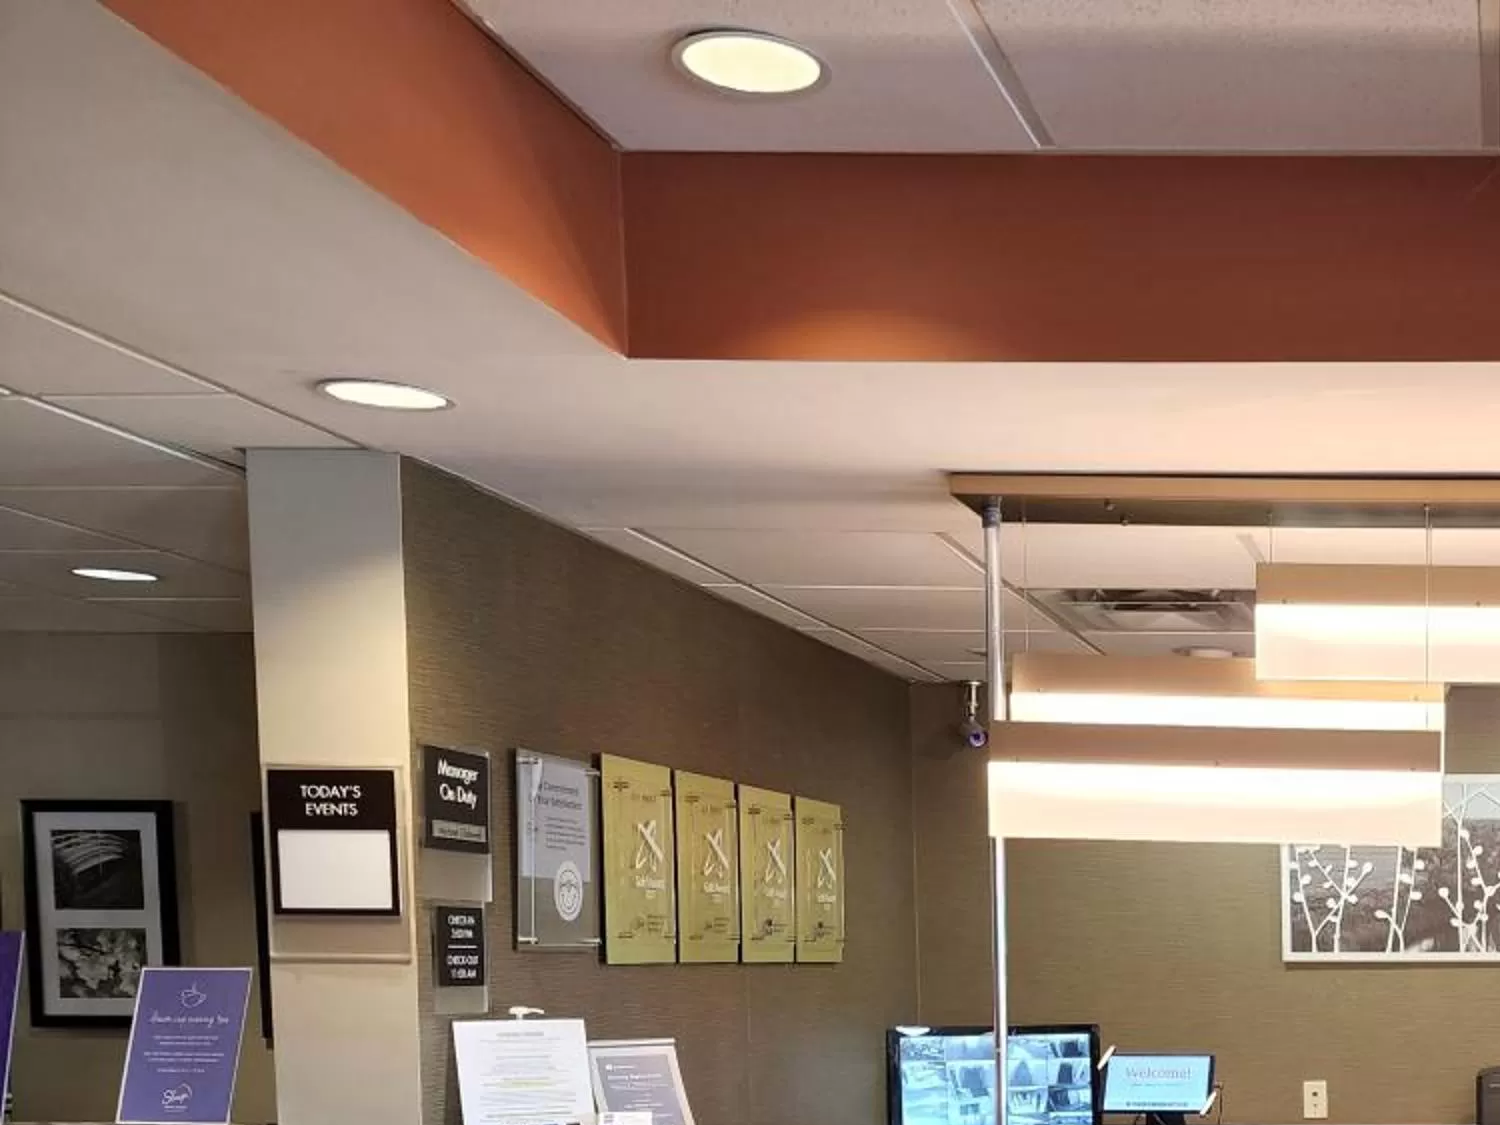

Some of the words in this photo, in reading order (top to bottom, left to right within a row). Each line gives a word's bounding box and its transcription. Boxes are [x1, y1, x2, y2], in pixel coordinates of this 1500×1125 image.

[437, 758, 479, 785] Manager
[299, 784, 362, 799] TODAY'S
[439, 783, 455, 801] On
[456, 785, 478, 810] Duty
[305, 802, 359, 817] EVENTS
